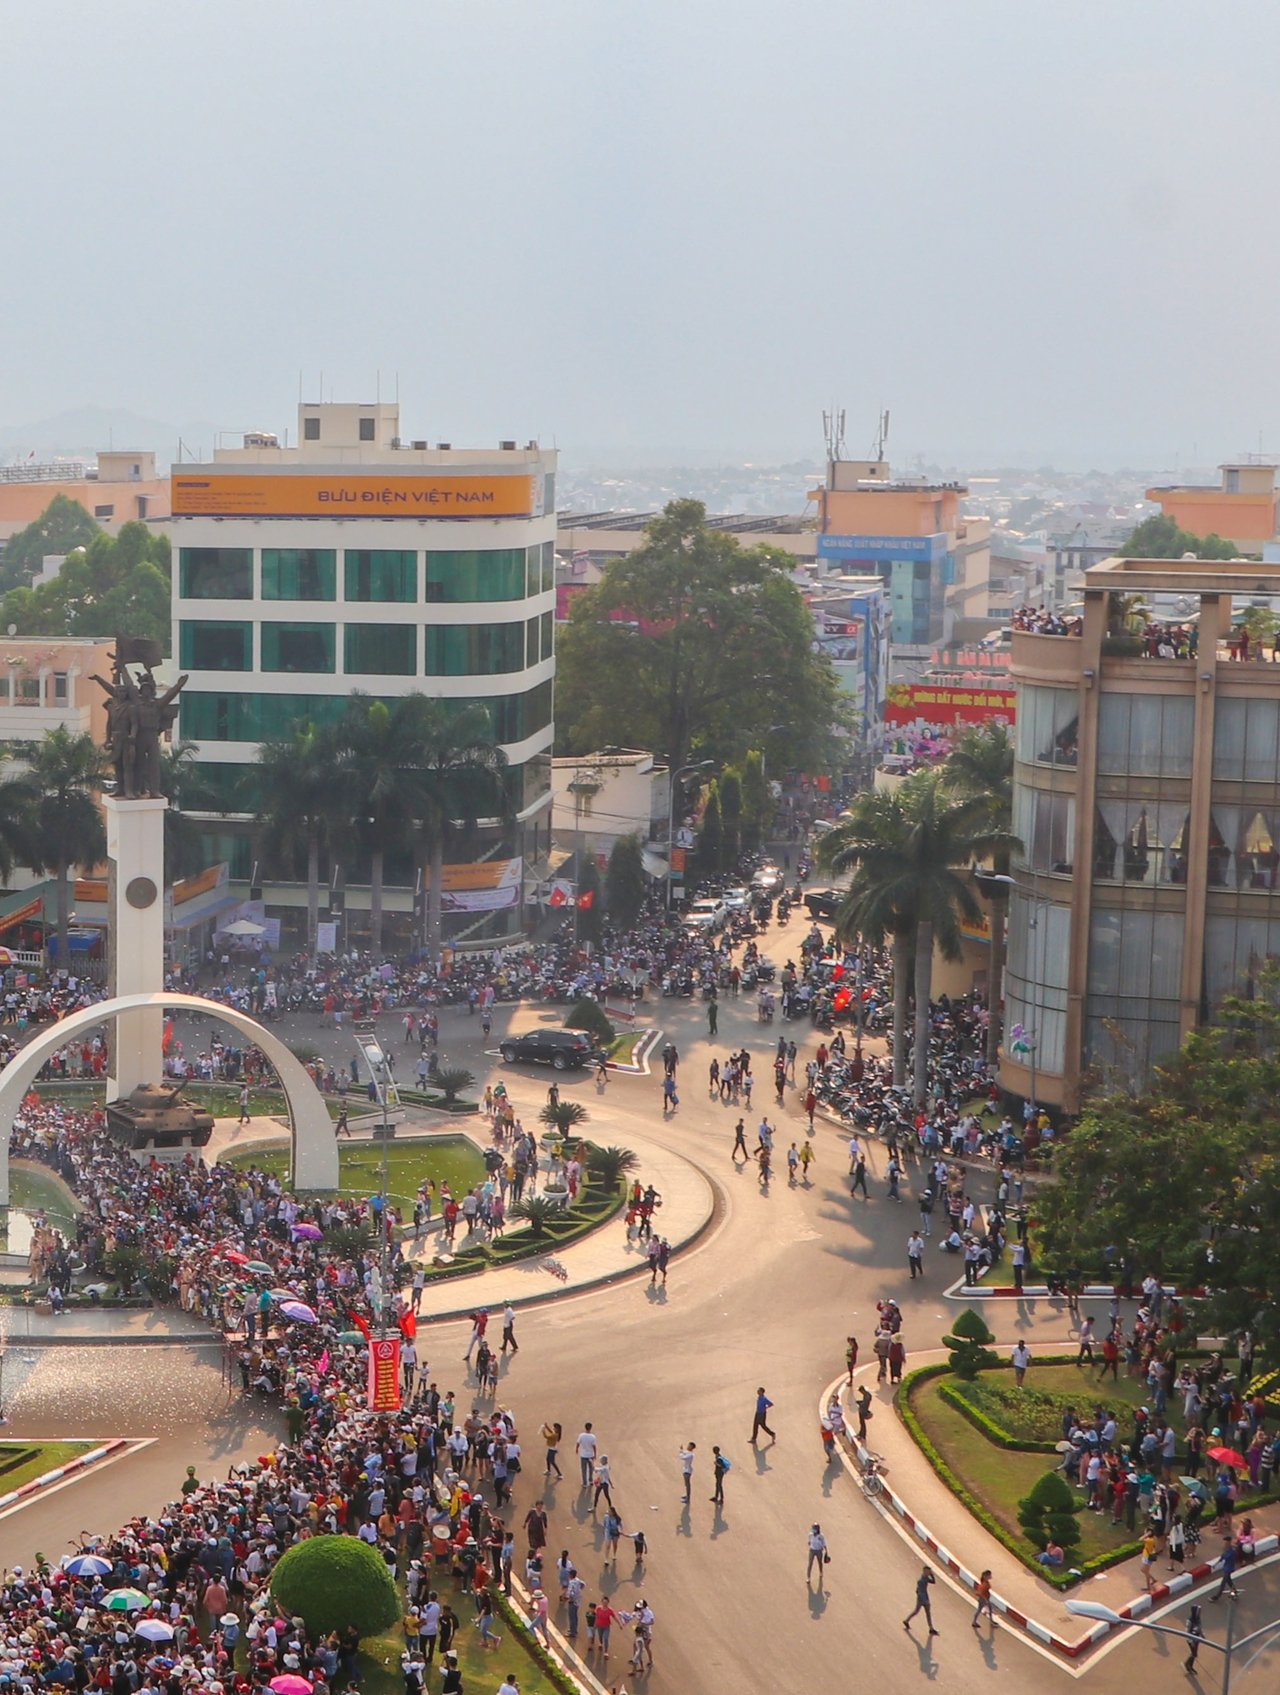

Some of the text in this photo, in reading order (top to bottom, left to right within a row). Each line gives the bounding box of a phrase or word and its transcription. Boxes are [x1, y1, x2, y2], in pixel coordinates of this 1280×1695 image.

[361, 488, 407, 505] ĐIỆN
[411, 488, 453, 505] VIỆT
[455, 492, 494, 502] NAM
